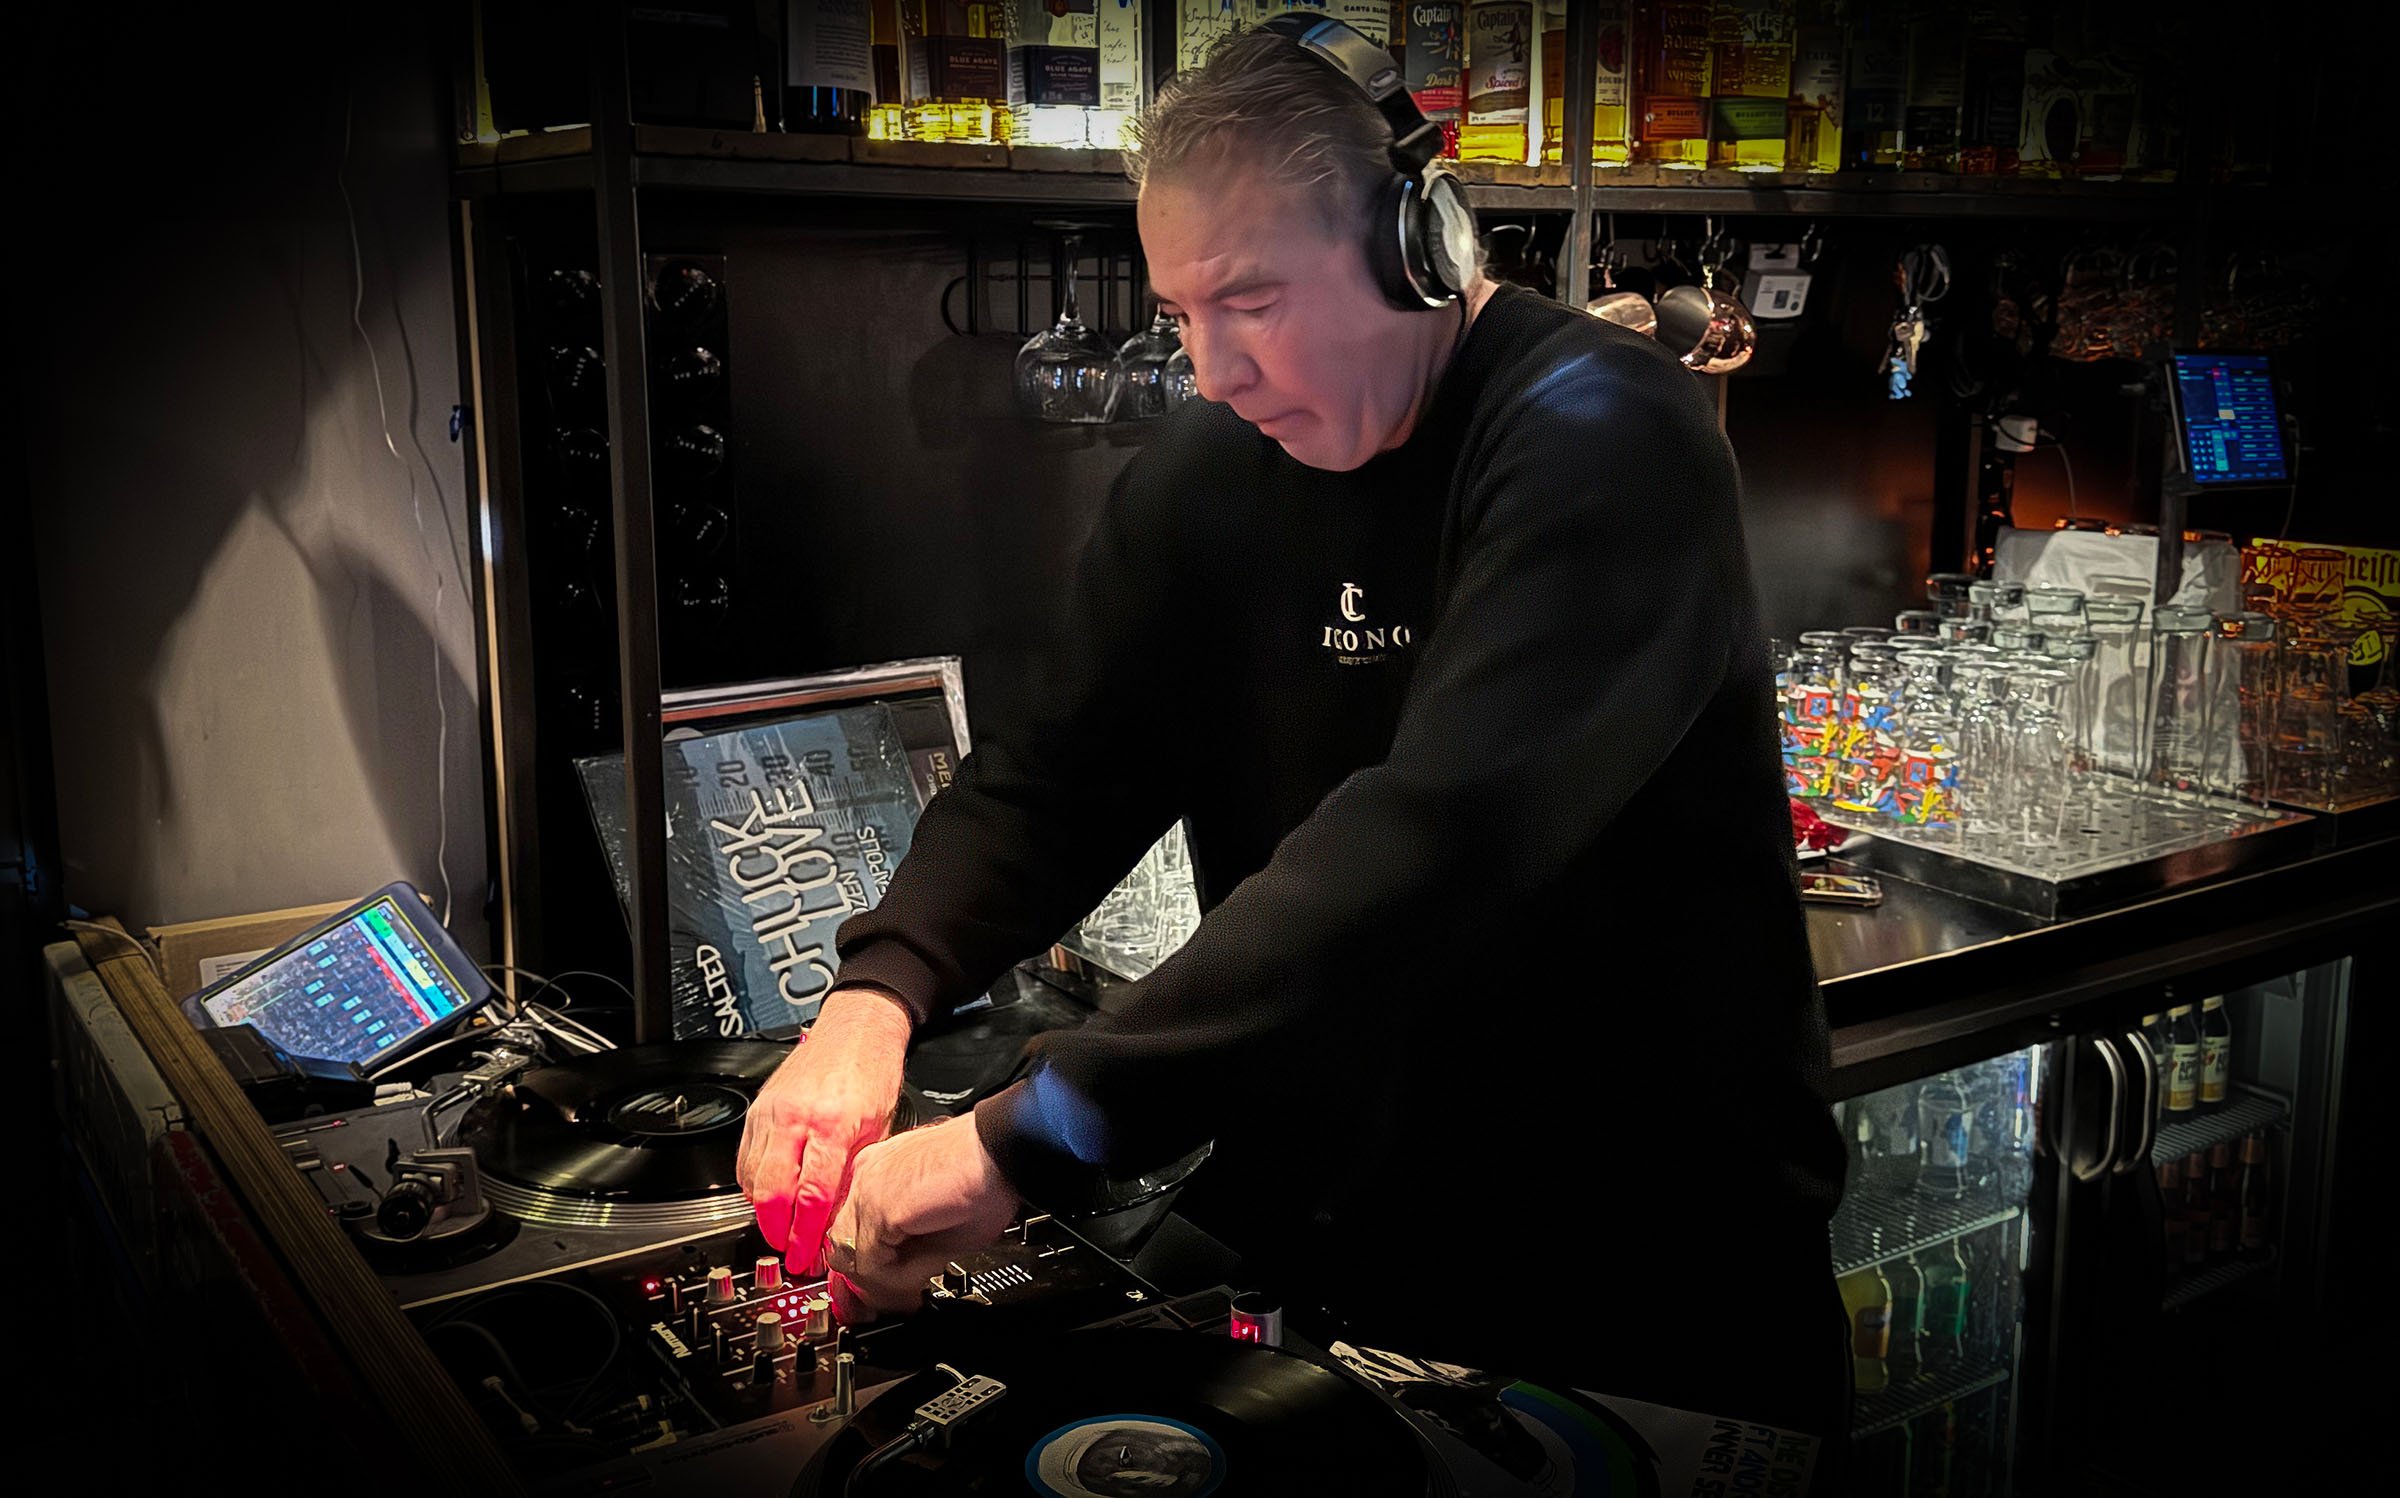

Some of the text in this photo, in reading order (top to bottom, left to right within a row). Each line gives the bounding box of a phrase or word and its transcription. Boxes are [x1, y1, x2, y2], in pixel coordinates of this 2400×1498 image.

[1412, 4, 1451, 27] Captain
[1478, 10, 1516, 30] Captain
[949, 55, 998, 65] BLUE AGAVE
[1044, 64, 1093, 74] BLUE AGAVE
[717, 760, 749, 788] 20
[803, 750, 835, 776] 40
[751, 778, 854, 923] LOVE
[856, 825, 890, 898] EAPOLIS
[710, 805, 835, 1007] CHUCK
[839, 870, 869, 916] ZEN
[696, 944, 744, 1037] SALTED
